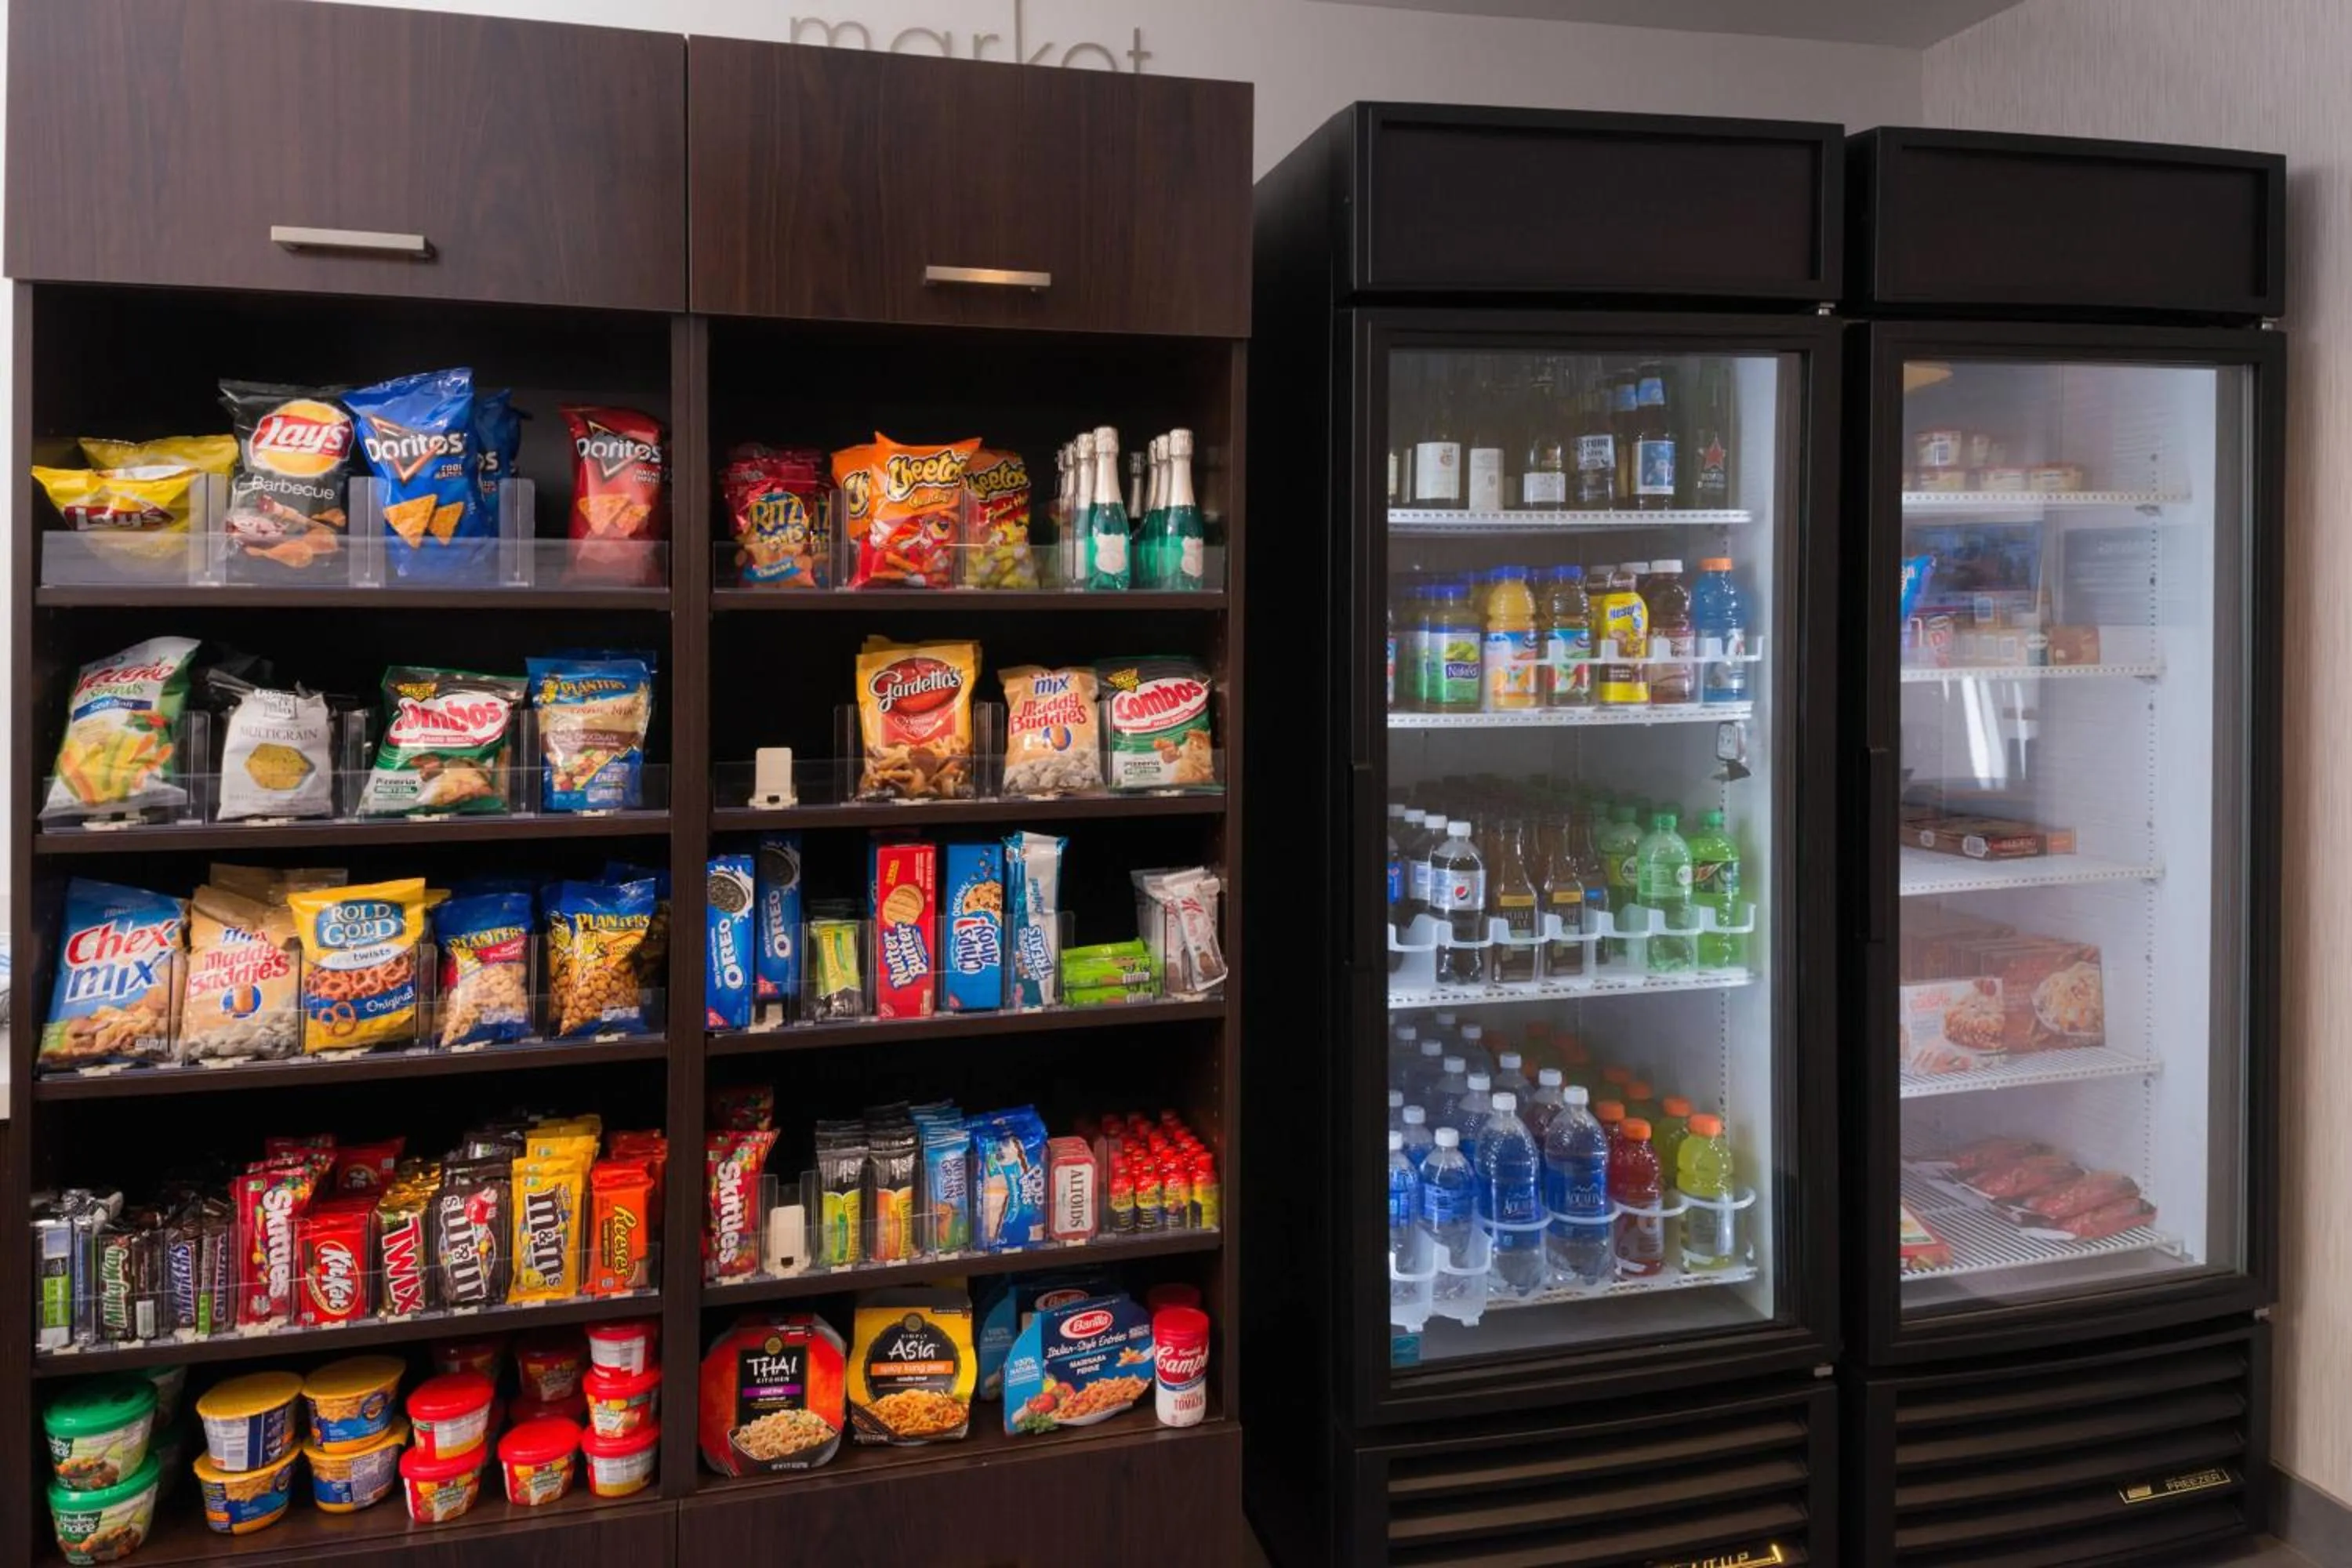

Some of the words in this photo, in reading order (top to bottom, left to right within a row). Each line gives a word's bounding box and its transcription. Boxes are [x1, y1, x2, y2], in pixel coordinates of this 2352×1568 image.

[365, 432, 466, 462] Doritos
[576, 437, 661, 463] Doritos
[252, 476, 336, 500] Barbecue
[869, 666, 963, 713] Gardetto's
[1114, 681, 1204, 721] Combos
[240, 726, 318, 740] MULTIGRAIN
[1010, 706, 1087, 735] Buddies
[322, 918, 397, 946] GOLD
[329, 902, 391, 923] ROLD
[575, 913, 650, 931] PLANTERS
[768, 891, 791, 958] OREO
[66, 920, 179, 967] Chex
[718, 918, 744, 990] OREO
[884, 931, 910, 988] Nutter
[897, 923, 927, 979] Butter
[958, 928, 983, 973] Chips
[1028, 924, 1054, 980] TREATS
[67, 951, 169, 1000] mix
[366, 986, 415, 1012] Original
[717, 1160, 744, 1265] Skittles
[1070, 1168, 1084, 1229] ALTOIDS
[262, 1189, 292, 1298] Skittles
[382, 1213, 426, 1316] TWIX
[1073, 1314, 1109, 1333] Barilla
[747, 1355, 797, 1377] THAI
[887, 1340, 936, 1360] Asia
